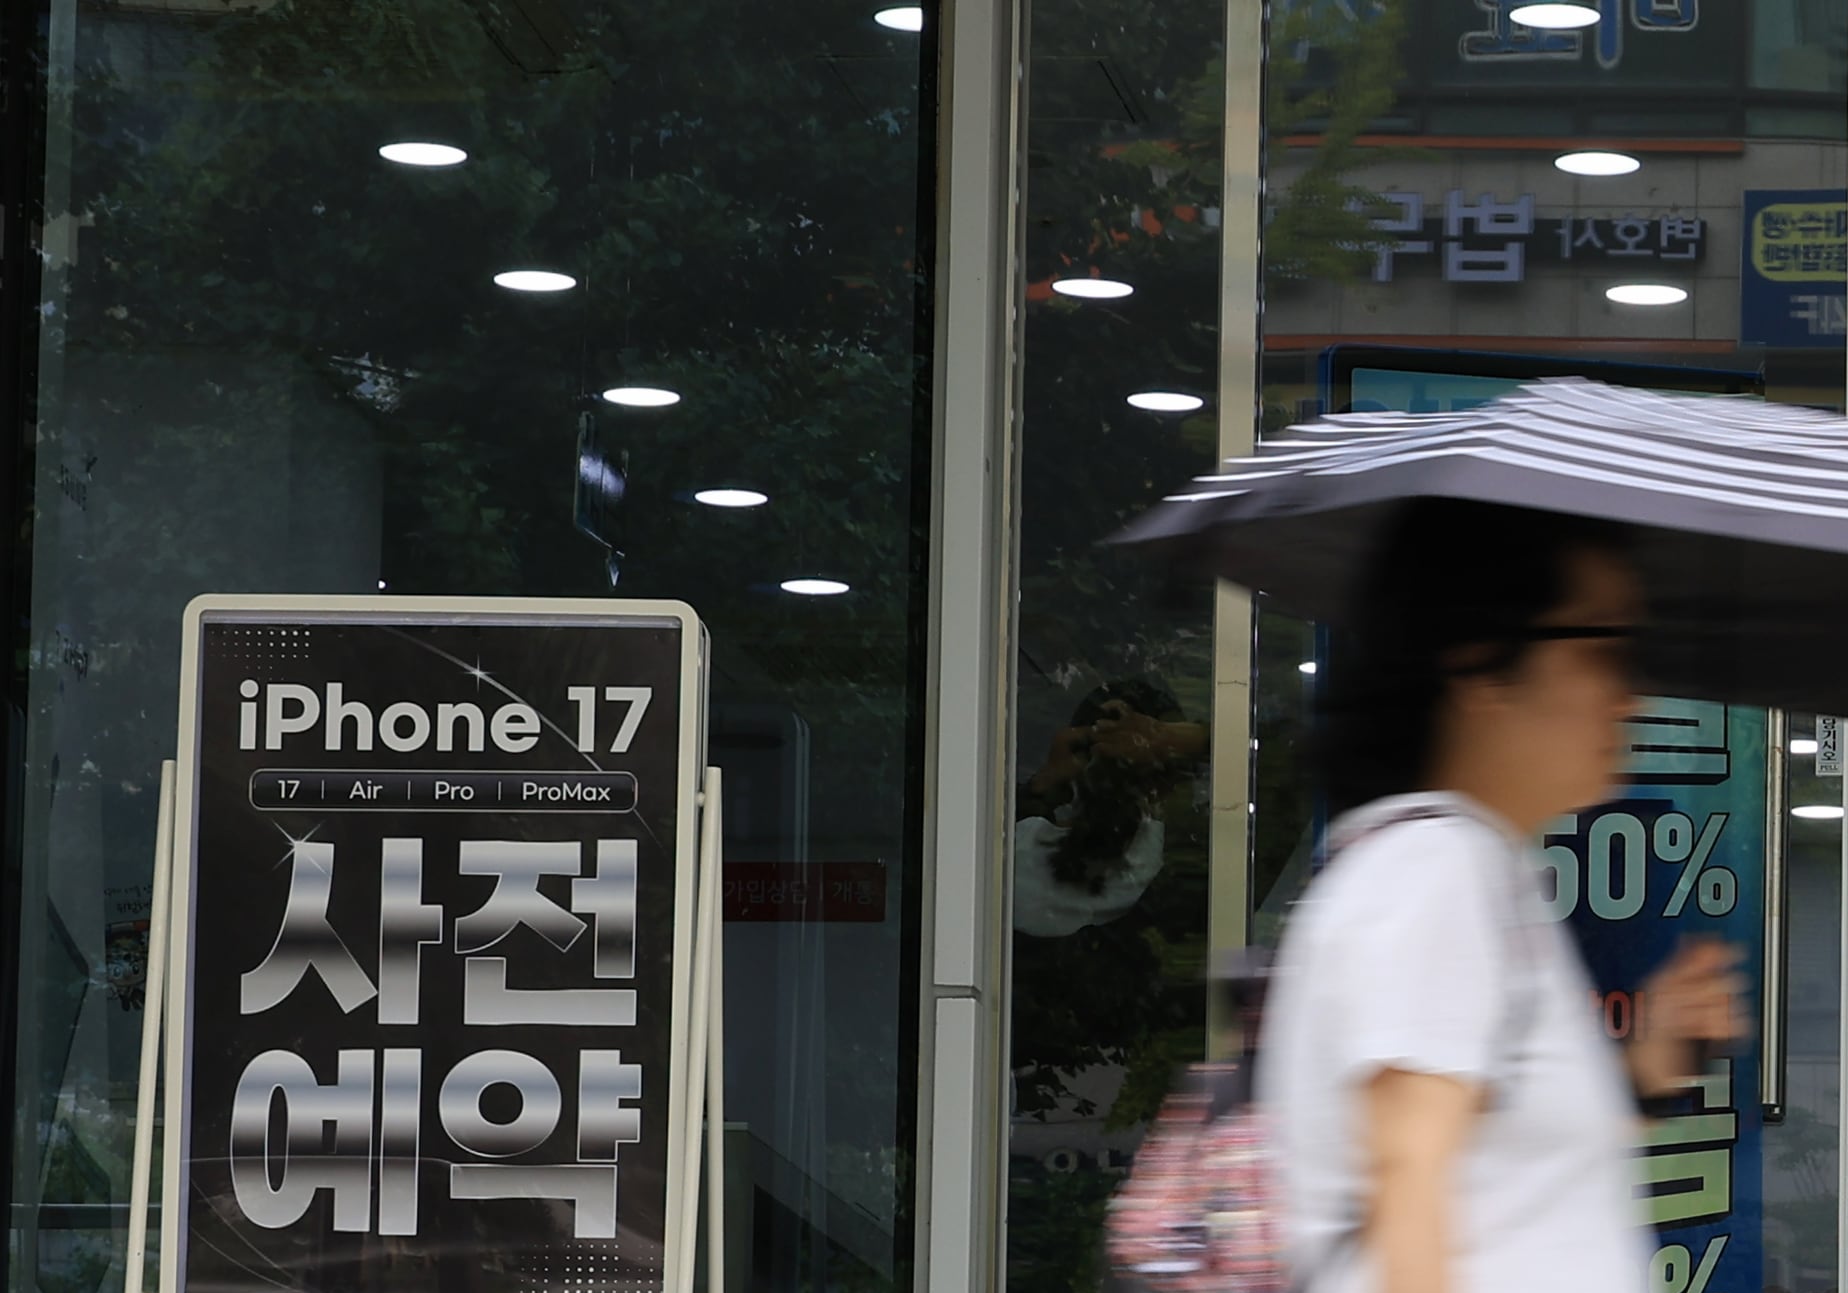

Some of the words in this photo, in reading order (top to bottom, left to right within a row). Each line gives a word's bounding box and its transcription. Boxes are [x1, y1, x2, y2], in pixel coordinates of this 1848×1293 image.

[239, 680, 541, 754] iPhone
[567, 687, 653, 754] 17
[277, 779, 301, 801] 17
[348, 779, 384, 801] Air
[433, 779, 475, 802] Pro
[520, 780, 612, 804] ProMax
[239, 836, 639, 1027] 사전
[230, 1047, 643, 1240] 예약
